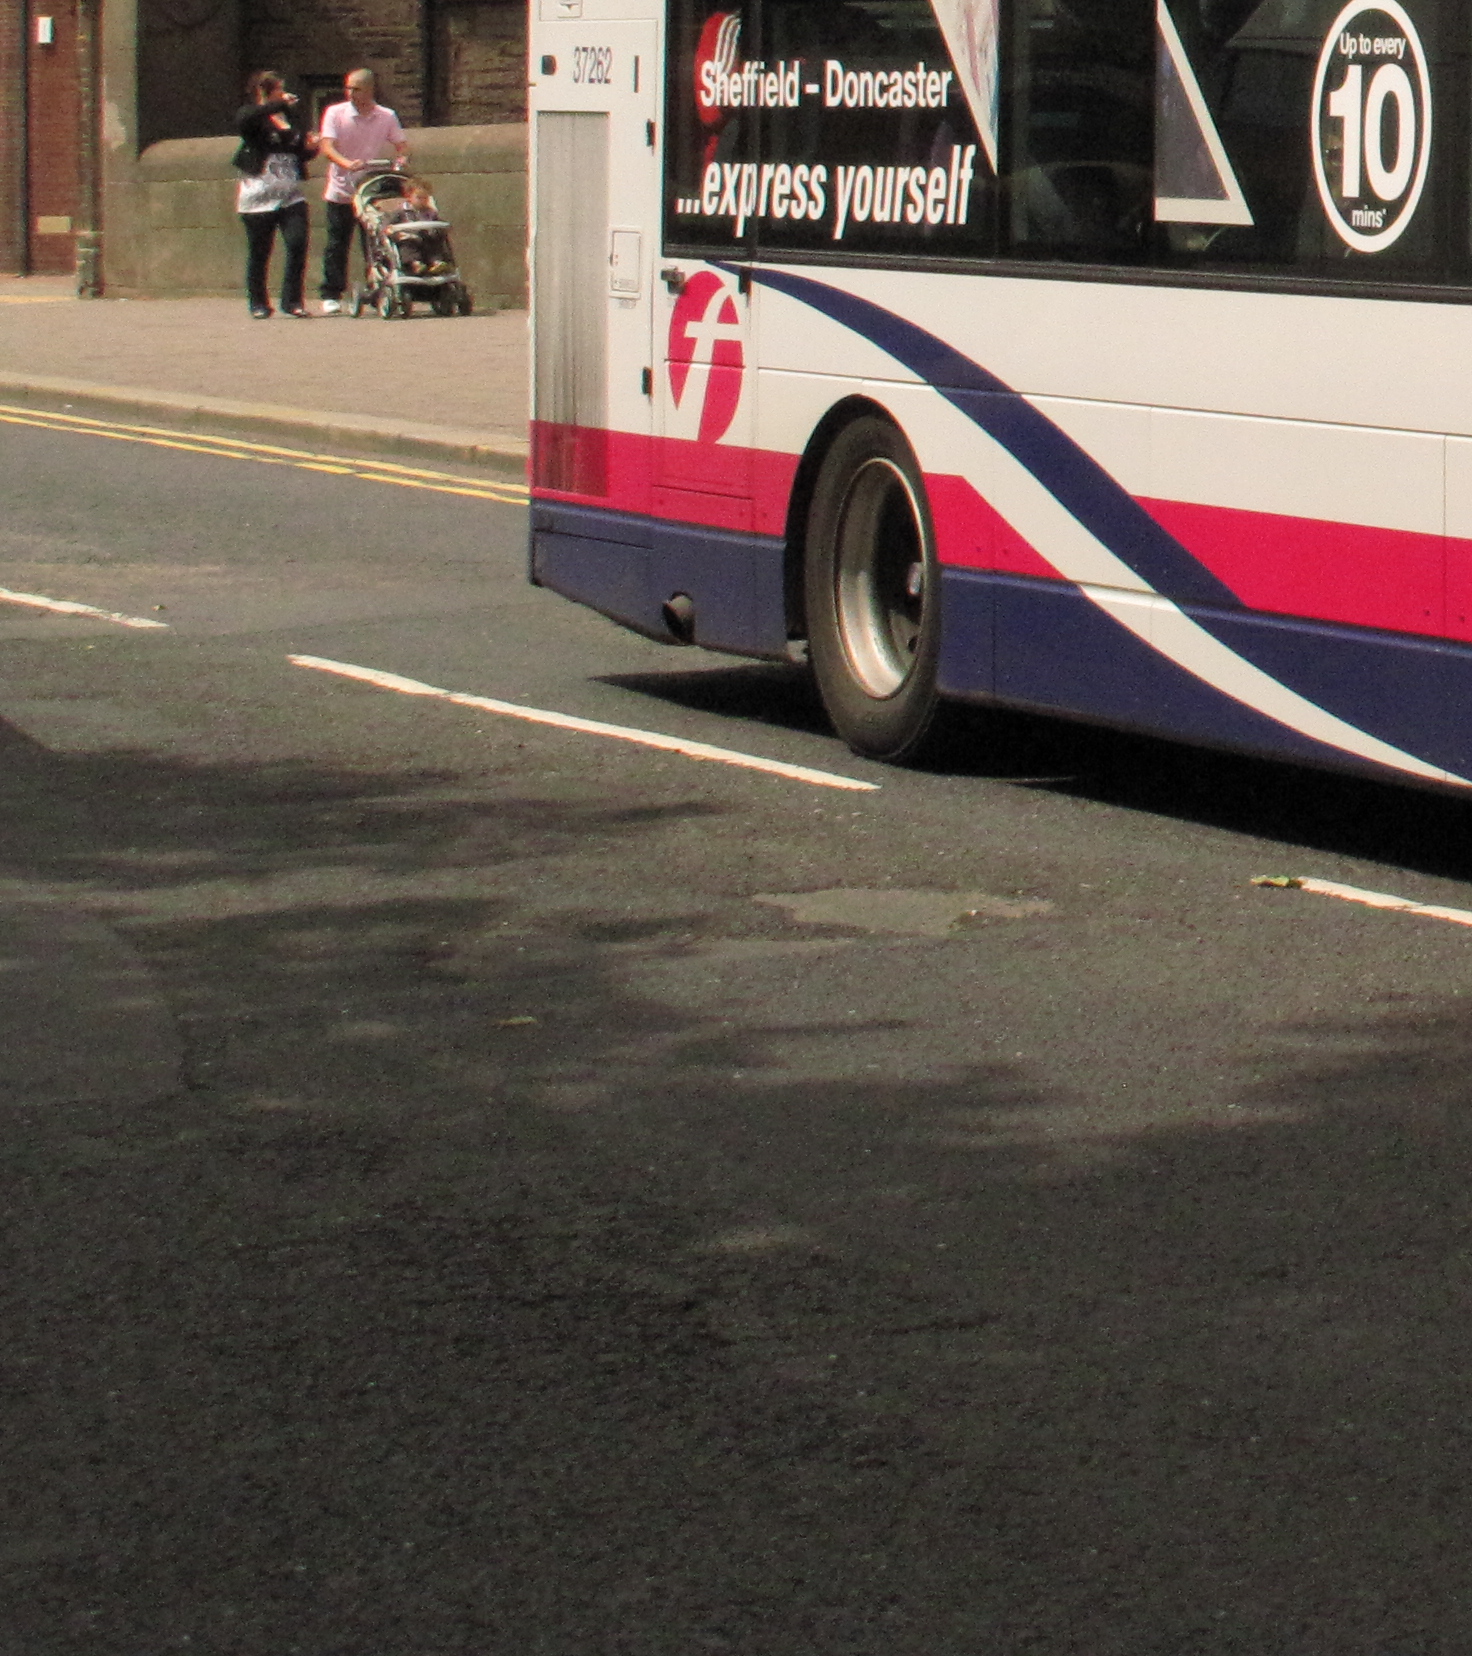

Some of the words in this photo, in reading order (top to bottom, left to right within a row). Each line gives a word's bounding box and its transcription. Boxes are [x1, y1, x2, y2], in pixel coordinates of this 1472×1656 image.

[573, 46, 612, 84] 37262
[1338, 32, 1358, 56] Up
[1358, 32, 1374, 55] to
[1374, 35, 1406, 60] every
[700, 60, 799, 108] Sheffield
[824, 58, 952, 108] Doncaster
[1329, 63, 1416, 201] 10
[832, 144, 976, 240] yourself
